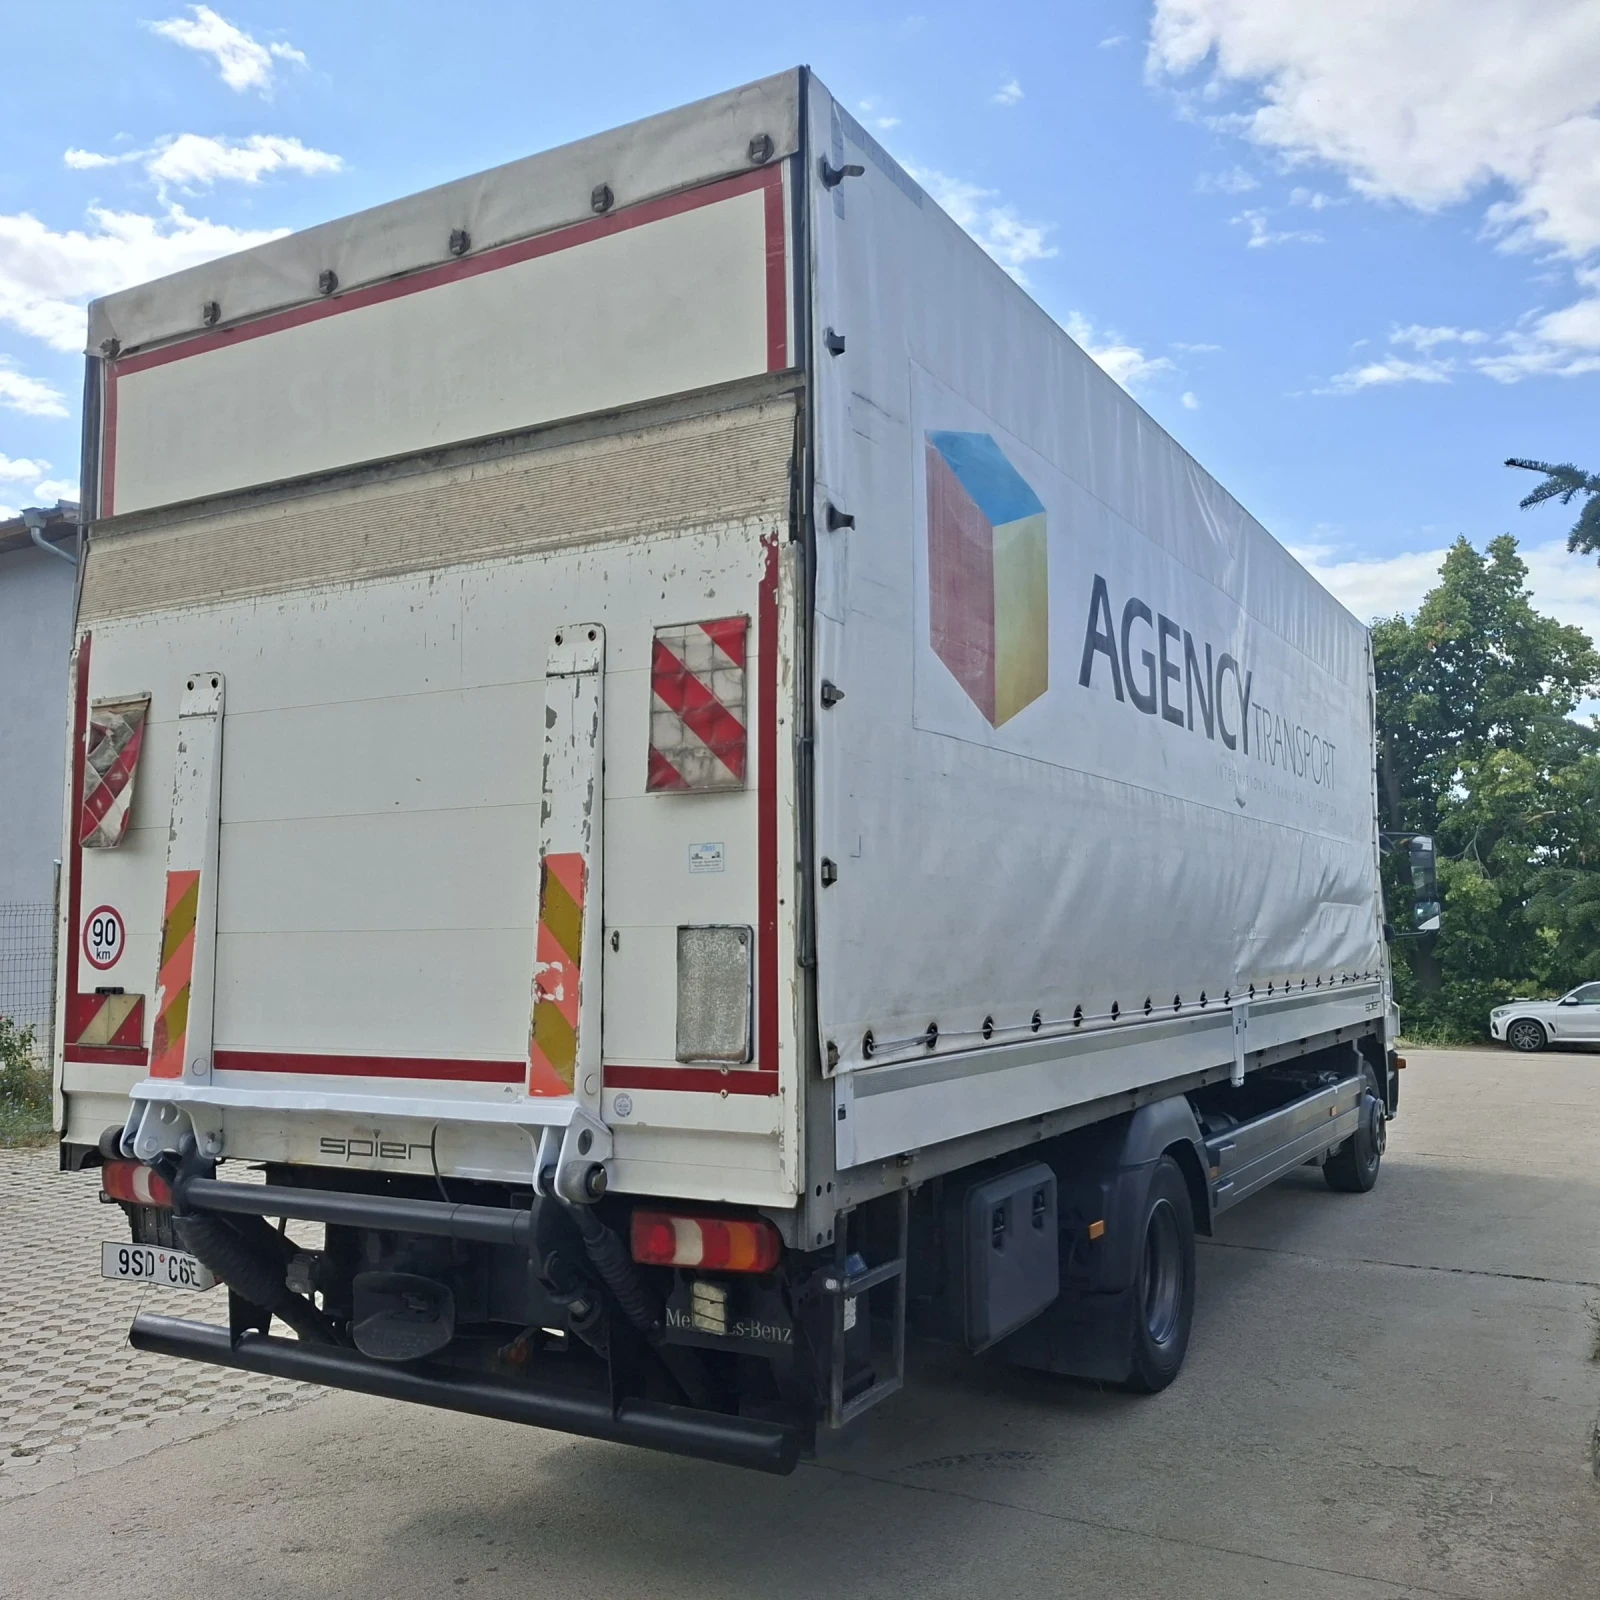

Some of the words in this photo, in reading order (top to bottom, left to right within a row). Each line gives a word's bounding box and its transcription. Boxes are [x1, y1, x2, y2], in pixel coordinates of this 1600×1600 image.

[1078, 573, 1252, 756] AGENCY
[1252, 701, 1336, 791] TRANSPORT
[92, 918, 116, 947] 90
[96, 947, 111, 960] km
[320, 1129, 432, 1162] spier
[118, 1248, 155, 1277] 9SD
[666, 1307, 794, 1344] Mes-Benz
